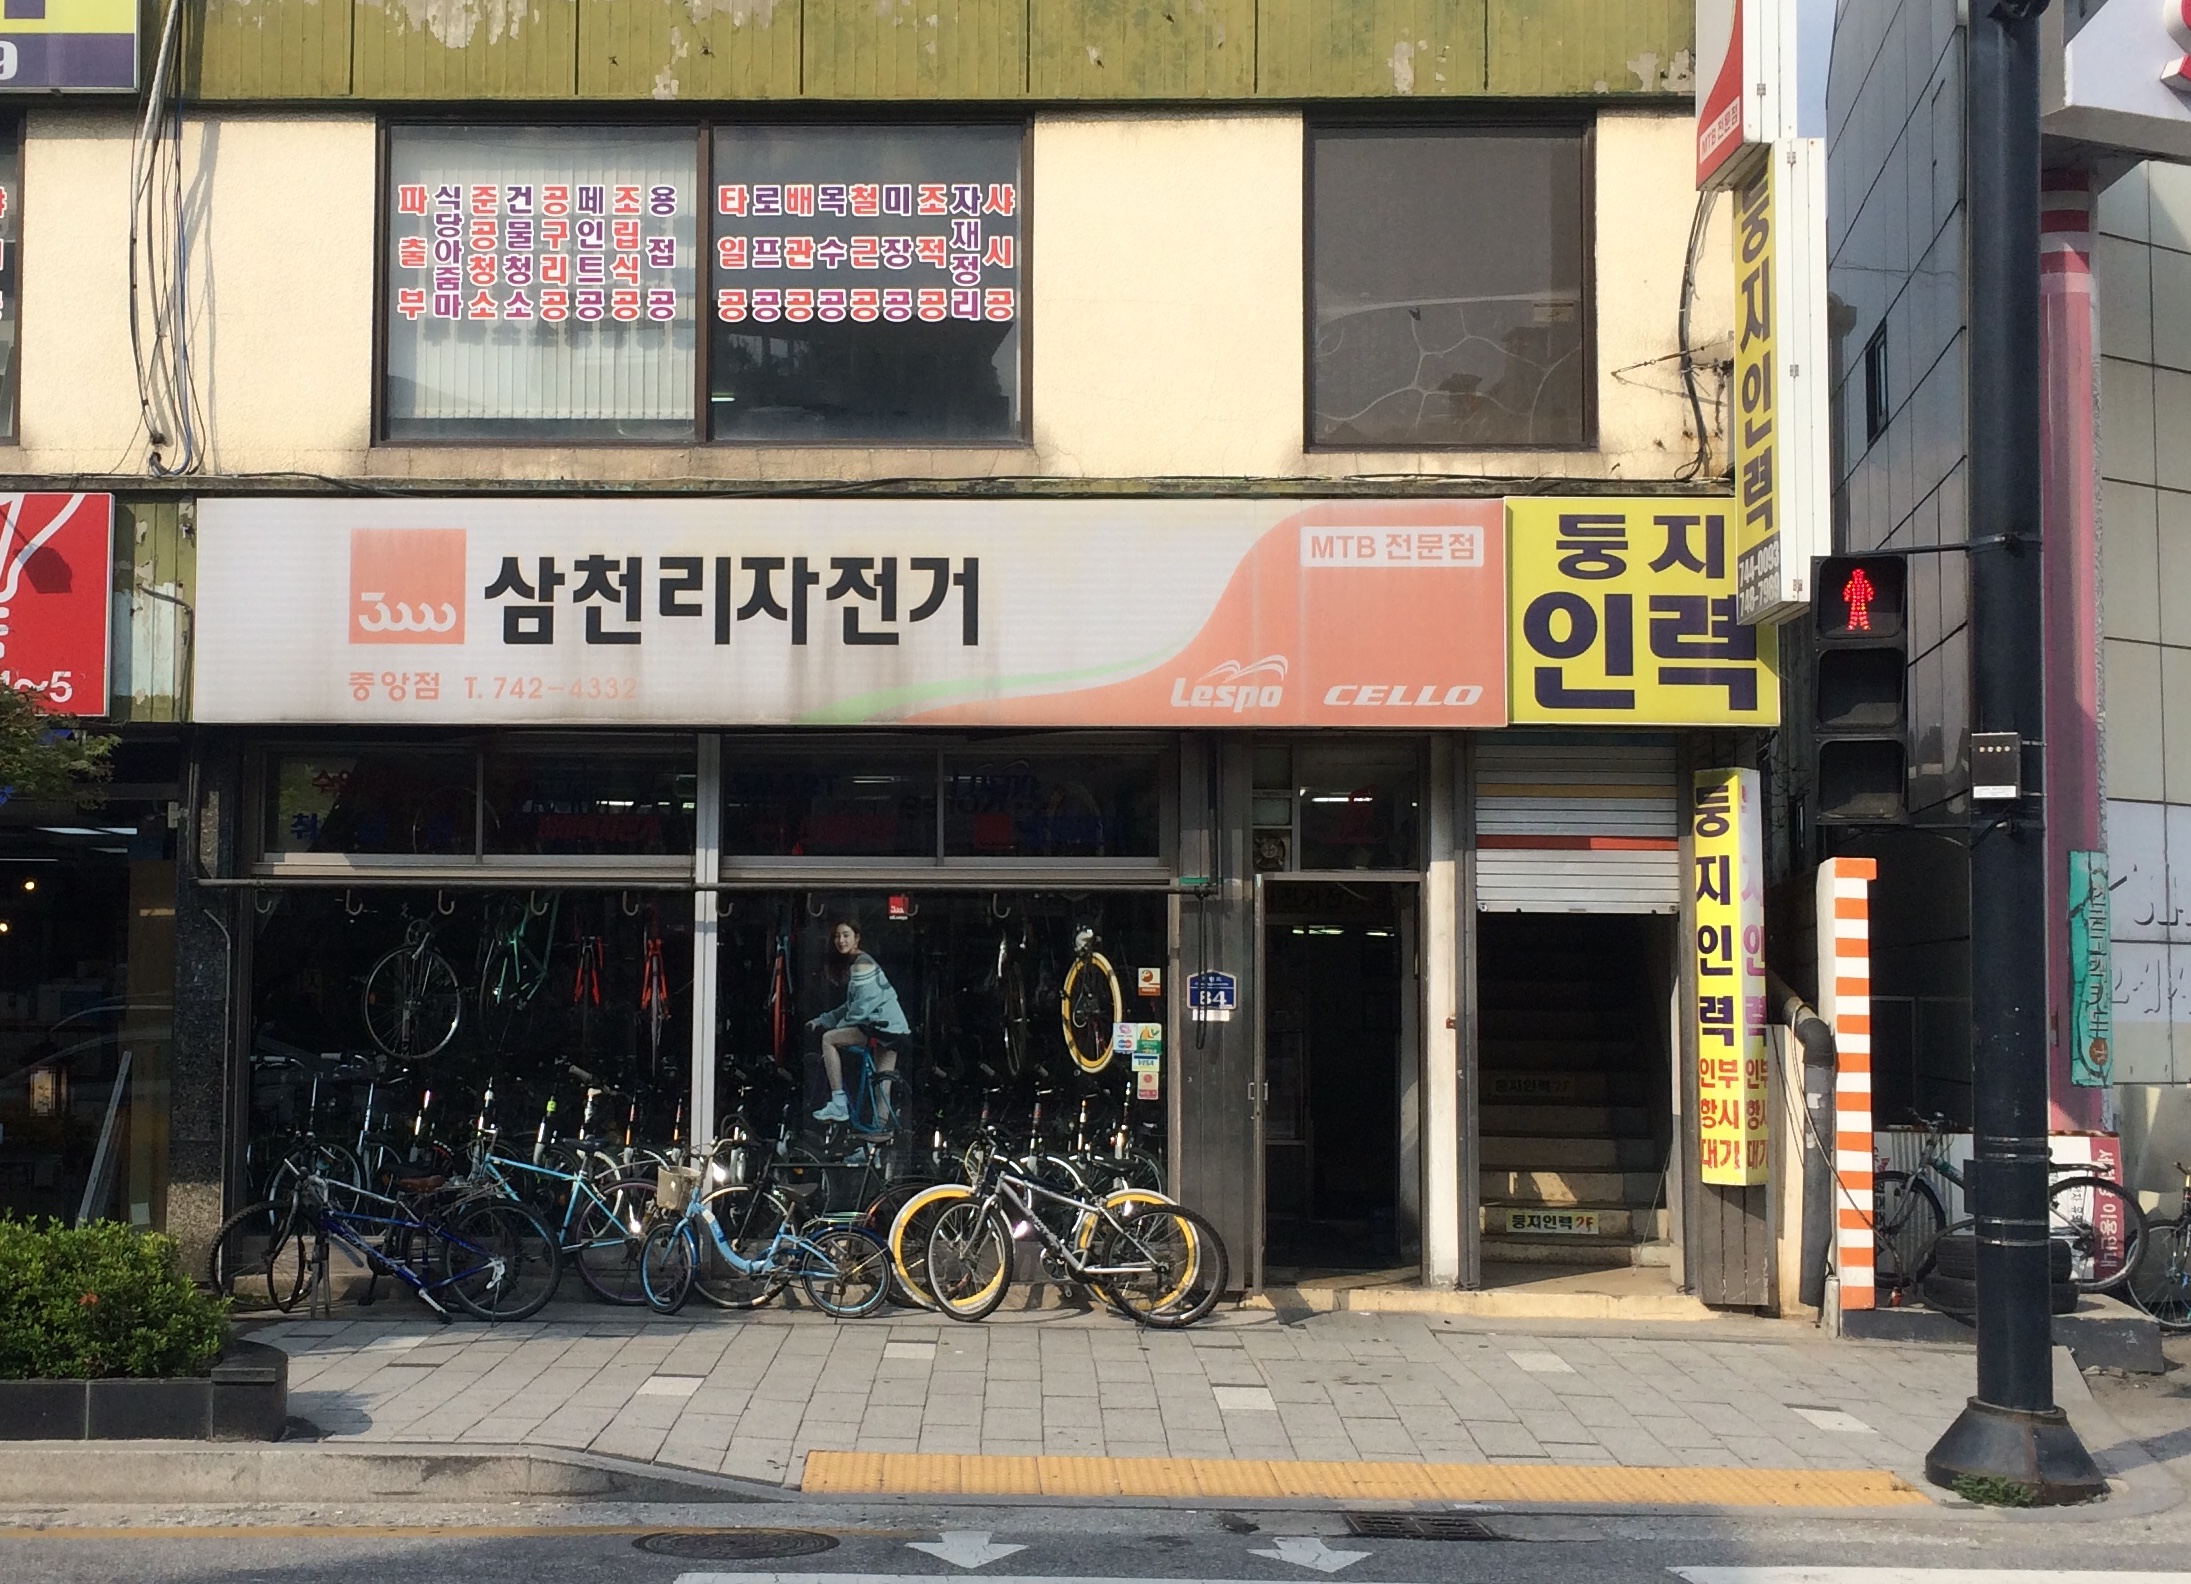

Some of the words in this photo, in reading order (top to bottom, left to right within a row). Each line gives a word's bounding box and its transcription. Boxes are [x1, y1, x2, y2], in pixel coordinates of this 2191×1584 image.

[398, 185, 427, 320] 파출부
[433, 185, 464, 319] 식당아줌마
[467, 185, 498, 320] 준공청소
[504, 185, 533, 320] 건물청소
[540, 185, 569, 321] 공구리공
[576, 185, 605, 321] 페인트공
[611, 185, 641, 321] 조립식공
[647, 185, 677, 321] 용접공
[718, 185, 748, 322] 타일공
[752, 185, 781, 322] 로프공
[785, 185, 814, 322] 배관공
[817, 185, 847, 322] 목수공
[849, 184, 879, 322] 철근공
[882, 185, 912, 322] 미장공
[916, 185, 947, 322] 조적공
[950, 184, 981, 321] 자재정리
[983, 184, 1015, 322] 샤시공
[1740, 165, 1773, 532] 둥지인력
[484, 554, 979, 646] 삼천리자전거
[1311, 535, 1376, 559] MTB
[1385, 533, 1475, 561] 전문점
[1556, 514, 1725, 580] 둥지
[1738, 540, 1780, 588] 744-0093
[348, 671, 442, 701] 중앙점
[1170, 677, 1283, 713] Lespo
[1323, 685, 1484, 706] CELLO
[1523, 591, 1758, 711] 인력
[1696, 785, 1734, 1047] 둥지인력
[1700, 1058, 1738, 1089] 인부
[1701, 1098, 1740, 1130] 항시
[1701, 1139, 1741, 1170] 대기
[1512, 1214, 1573, 1229] 둥지인력
[1575, 1216, 1594, 1231] 2F
